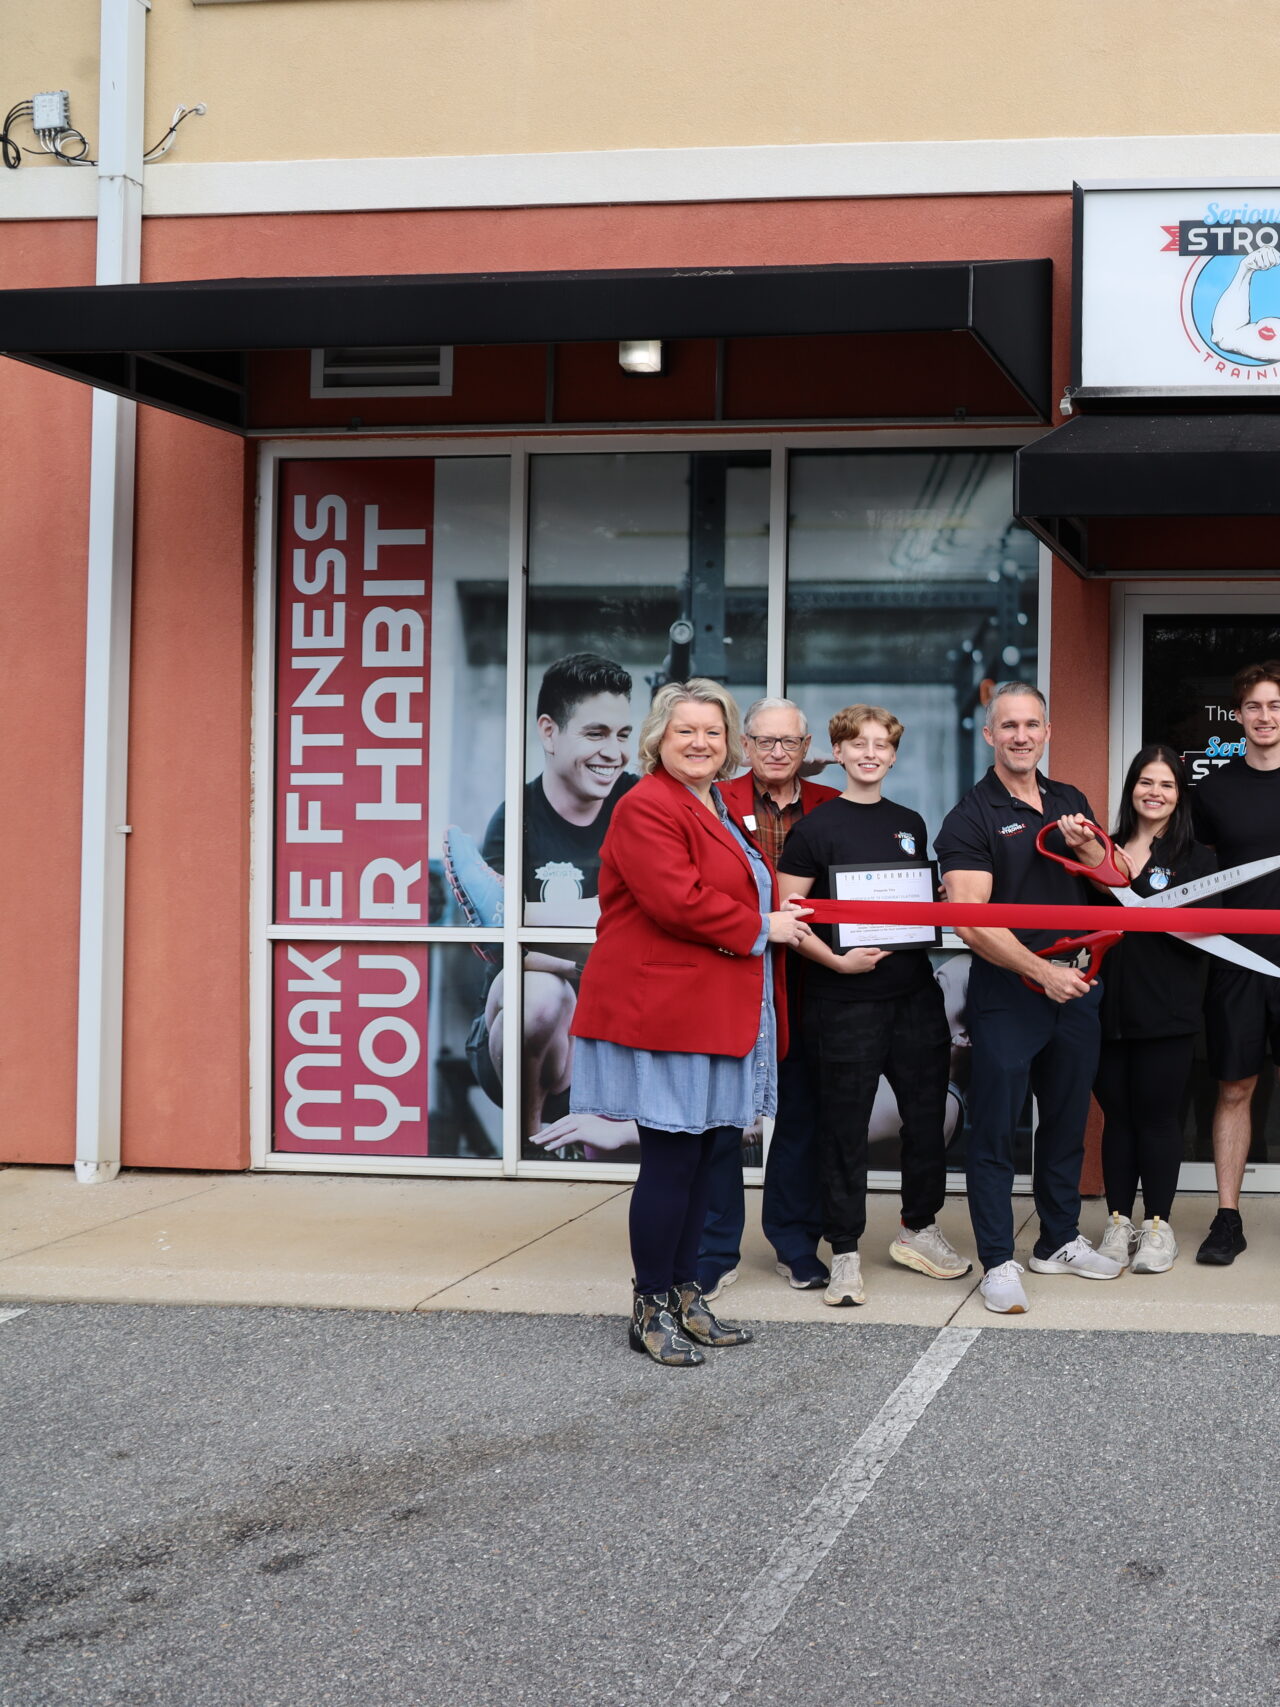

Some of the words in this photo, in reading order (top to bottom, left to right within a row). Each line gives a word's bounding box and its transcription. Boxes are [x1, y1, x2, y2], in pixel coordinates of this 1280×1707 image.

[286, 493, 348, 844] FITNESS
[355, 504, 428, 821] HABIT
[283, 870, 343, 1142] MAKE
[353, 857, 422, 1141] YOUR
